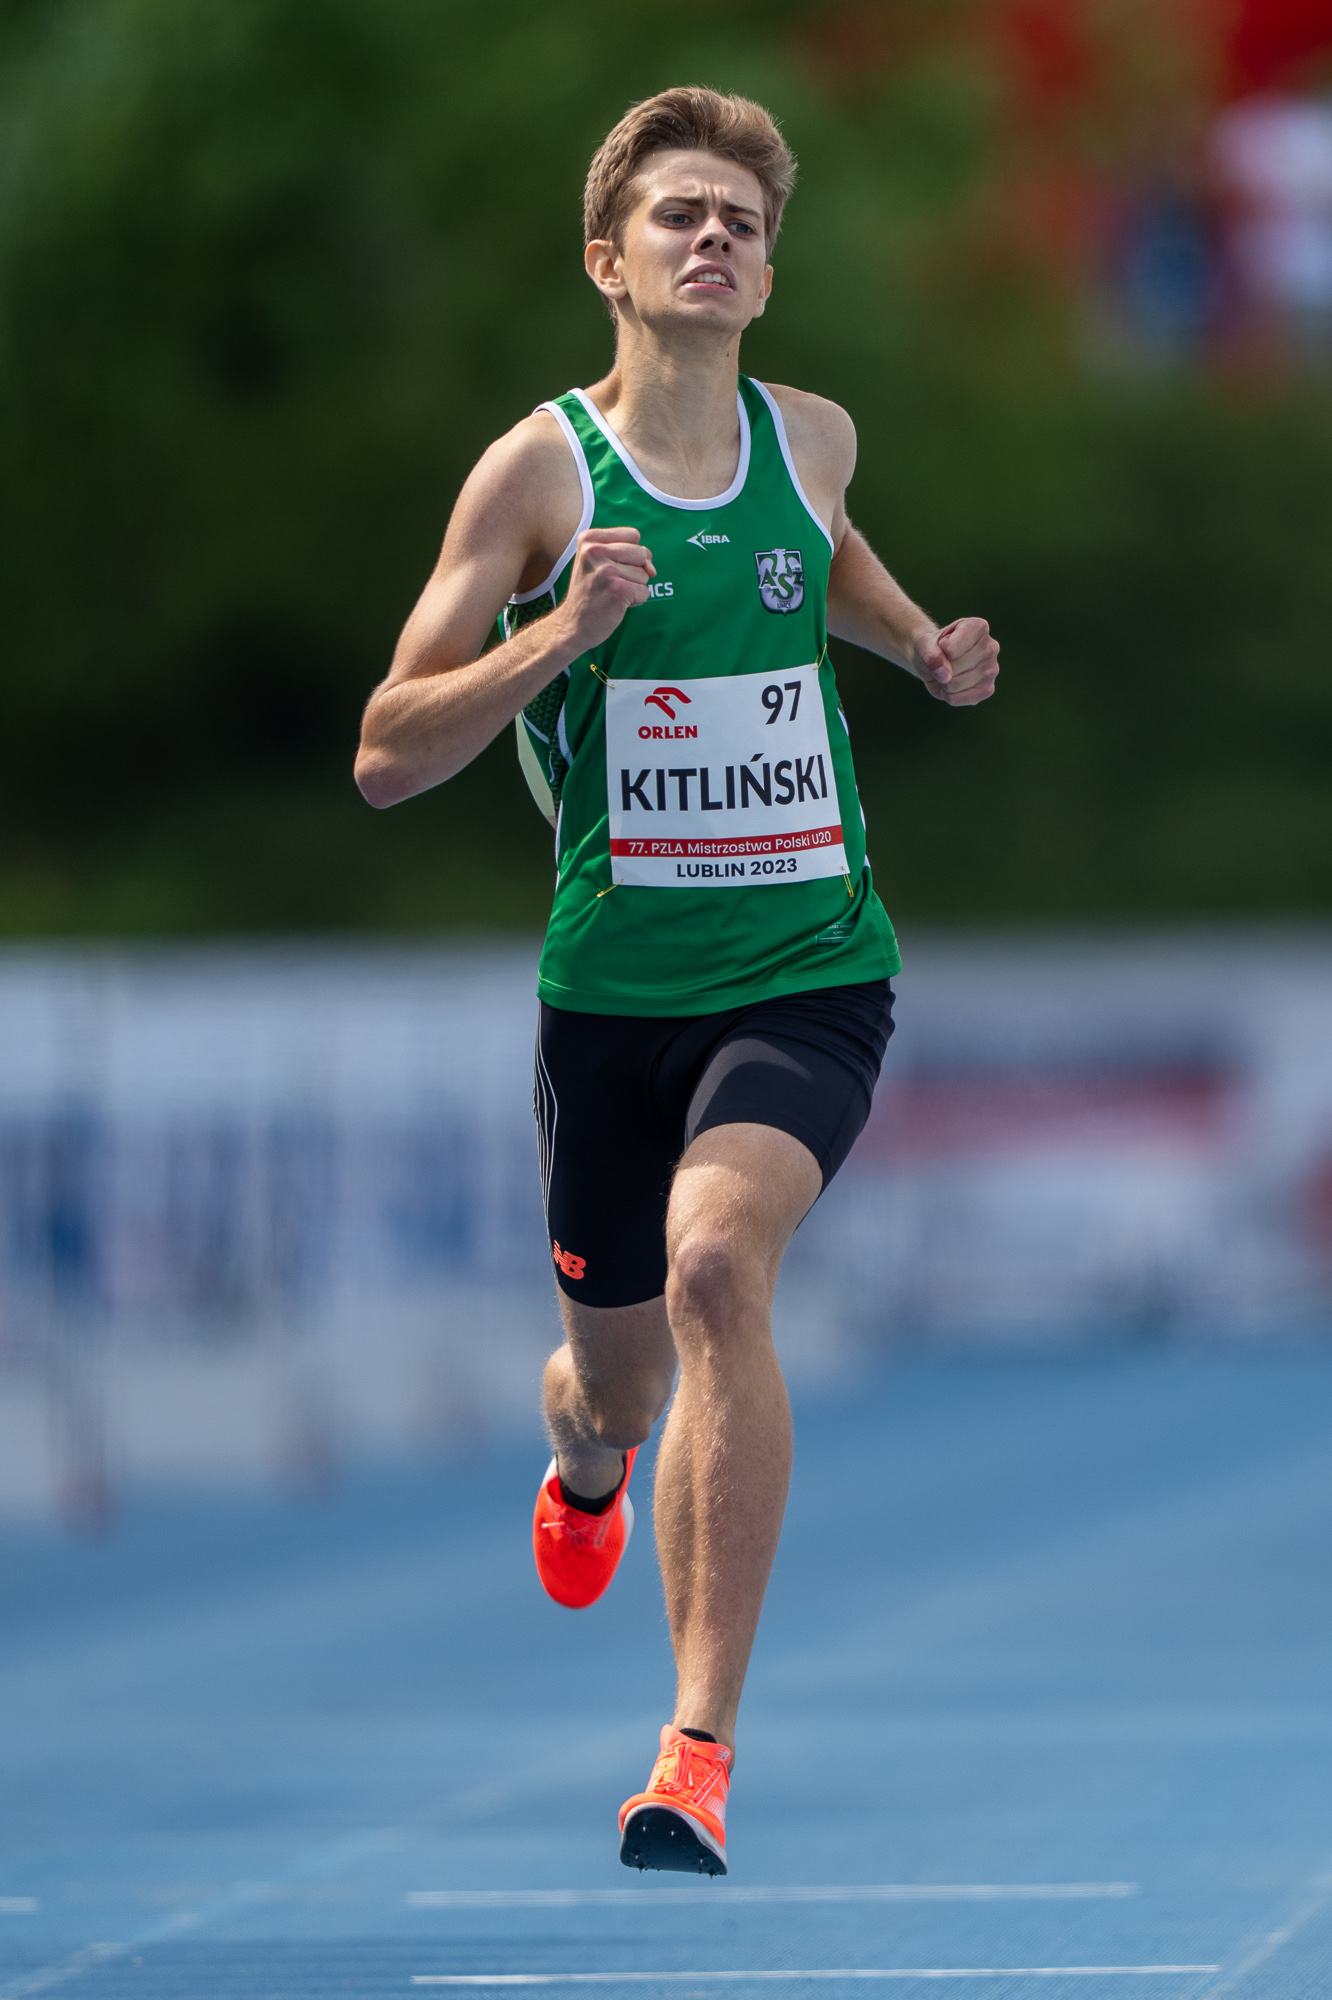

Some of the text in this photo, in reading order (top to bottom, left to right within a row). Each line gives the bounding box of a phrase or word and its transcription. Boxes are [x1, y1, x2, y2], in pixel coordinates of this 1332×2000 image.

[761, 681, 801, 725] 97
[638, 725, 698, 739] ORLEN
[621, 753, 828, 811] KITLIŃSKI
[628, 831, 832, 855] 77. PZLA Mistrzostwa Polski U20
[677, 857, 798, 877] LUBLIN 2023
